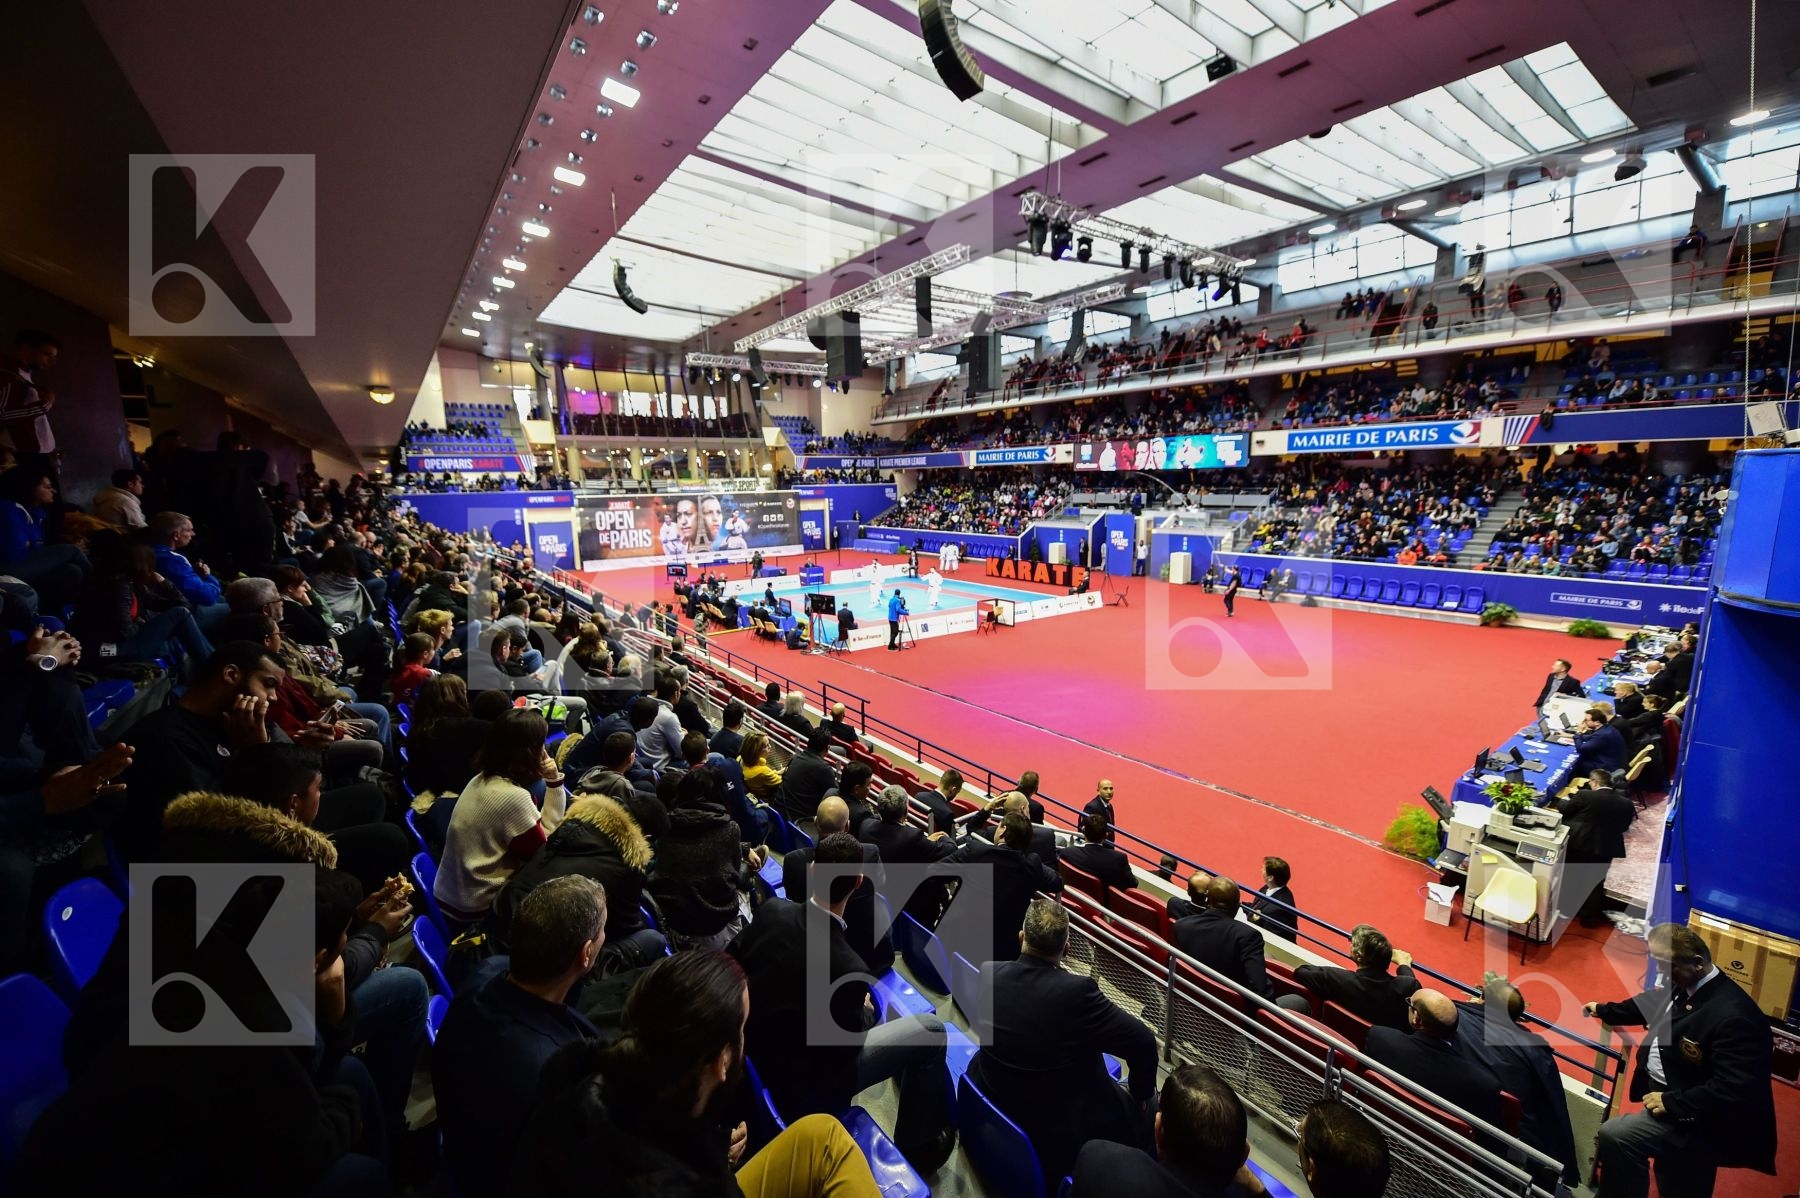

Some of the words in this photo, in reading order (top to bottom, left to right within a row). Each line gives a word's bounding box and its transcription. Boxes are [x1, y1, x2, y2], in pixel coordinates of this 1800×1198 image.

[1293, 433, 1351, 448] MAIRIE
[1355, 431, 1380, 445] DE
[1384, 427, 1439, 443] PARIS
[978, 452, 1004, 462] MAIRIE
[1005, 451, 1017, 461] DE
[1018, 450, 1040, 460] PARIS
[595, 510, 635, 531] OPEN
[538, 534, 559, 545] OPEN
[545, 542, 568, 555] PARIS
[599, 531, 611, 545] DE
[609, 529, 653, 550] PARIS
[986, 556, 1086, 588] KARATE
